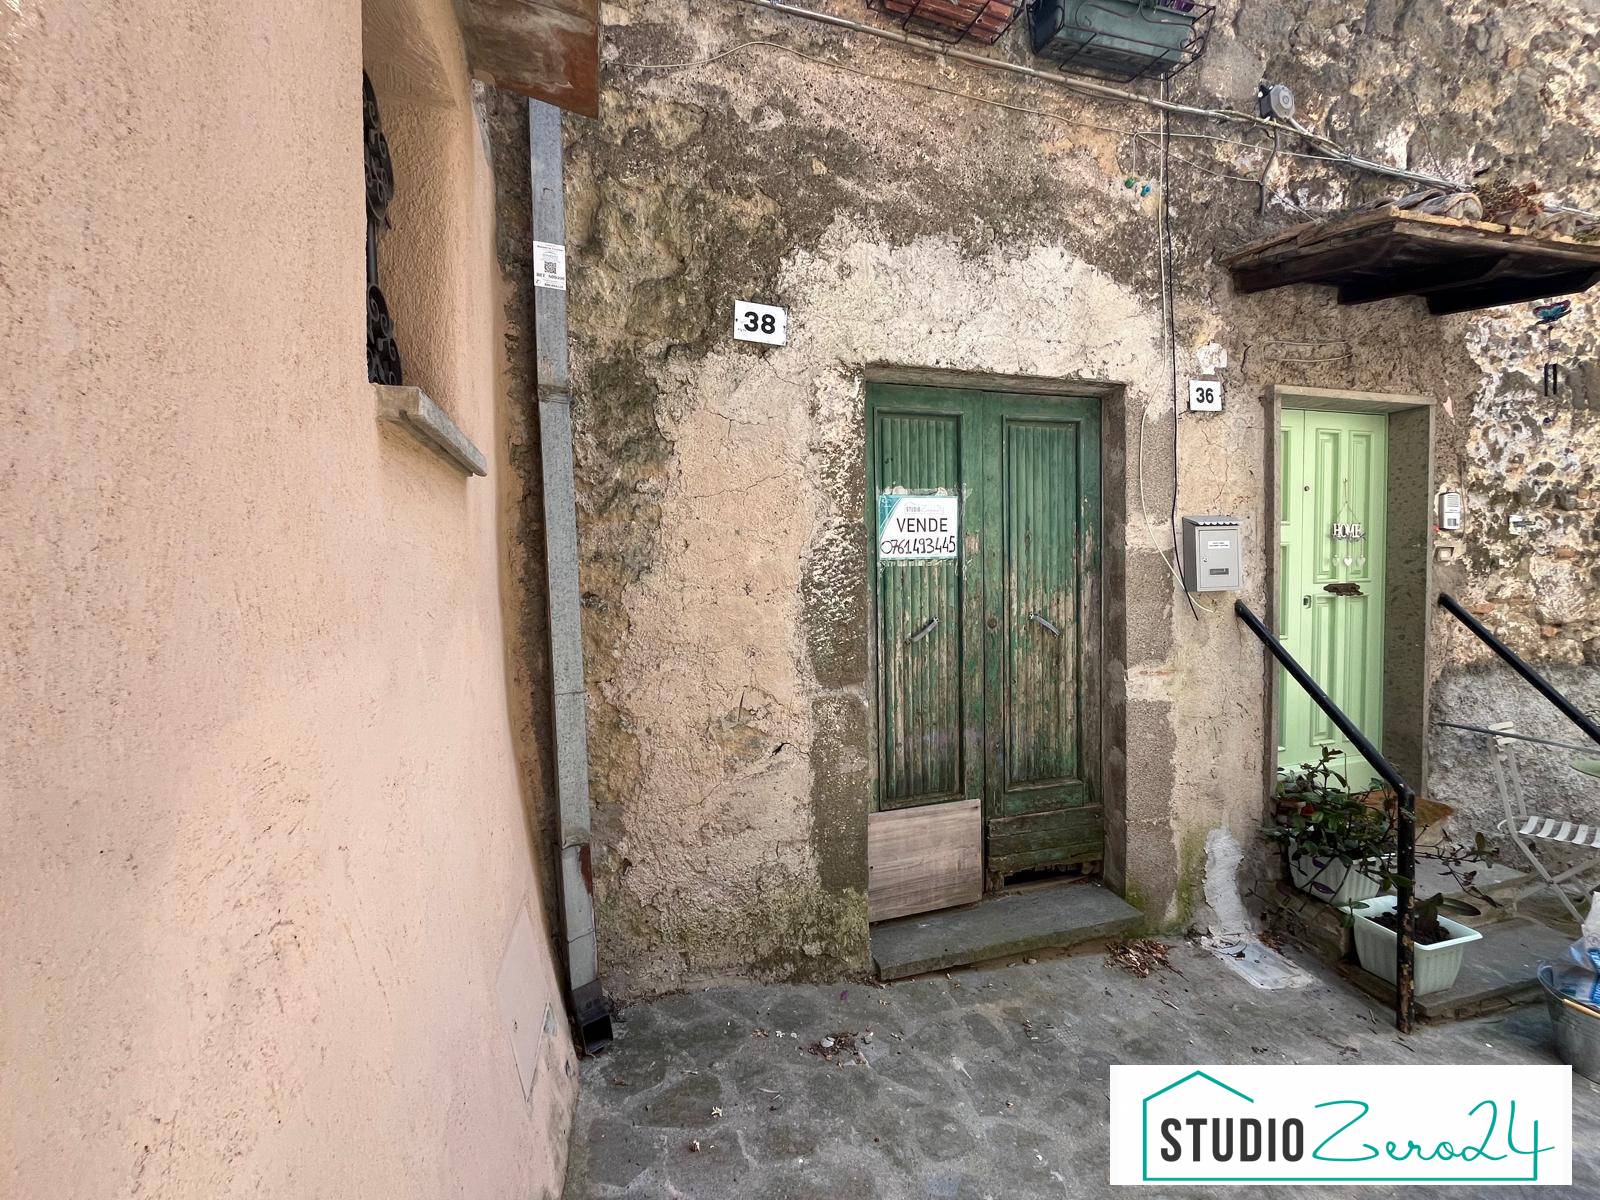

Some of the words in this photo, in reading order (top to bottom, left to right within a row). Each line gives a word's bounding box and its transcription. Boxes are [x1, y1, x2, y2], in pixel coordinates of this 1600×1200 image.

[743, 311, 776, 335] 38
[1195, 387, 1215, 404] 36
[896, 517, 949, 533] VENDE
[1332, 523, 1364, 538] HOME
[880, 535, 956, 555] 0761493445
